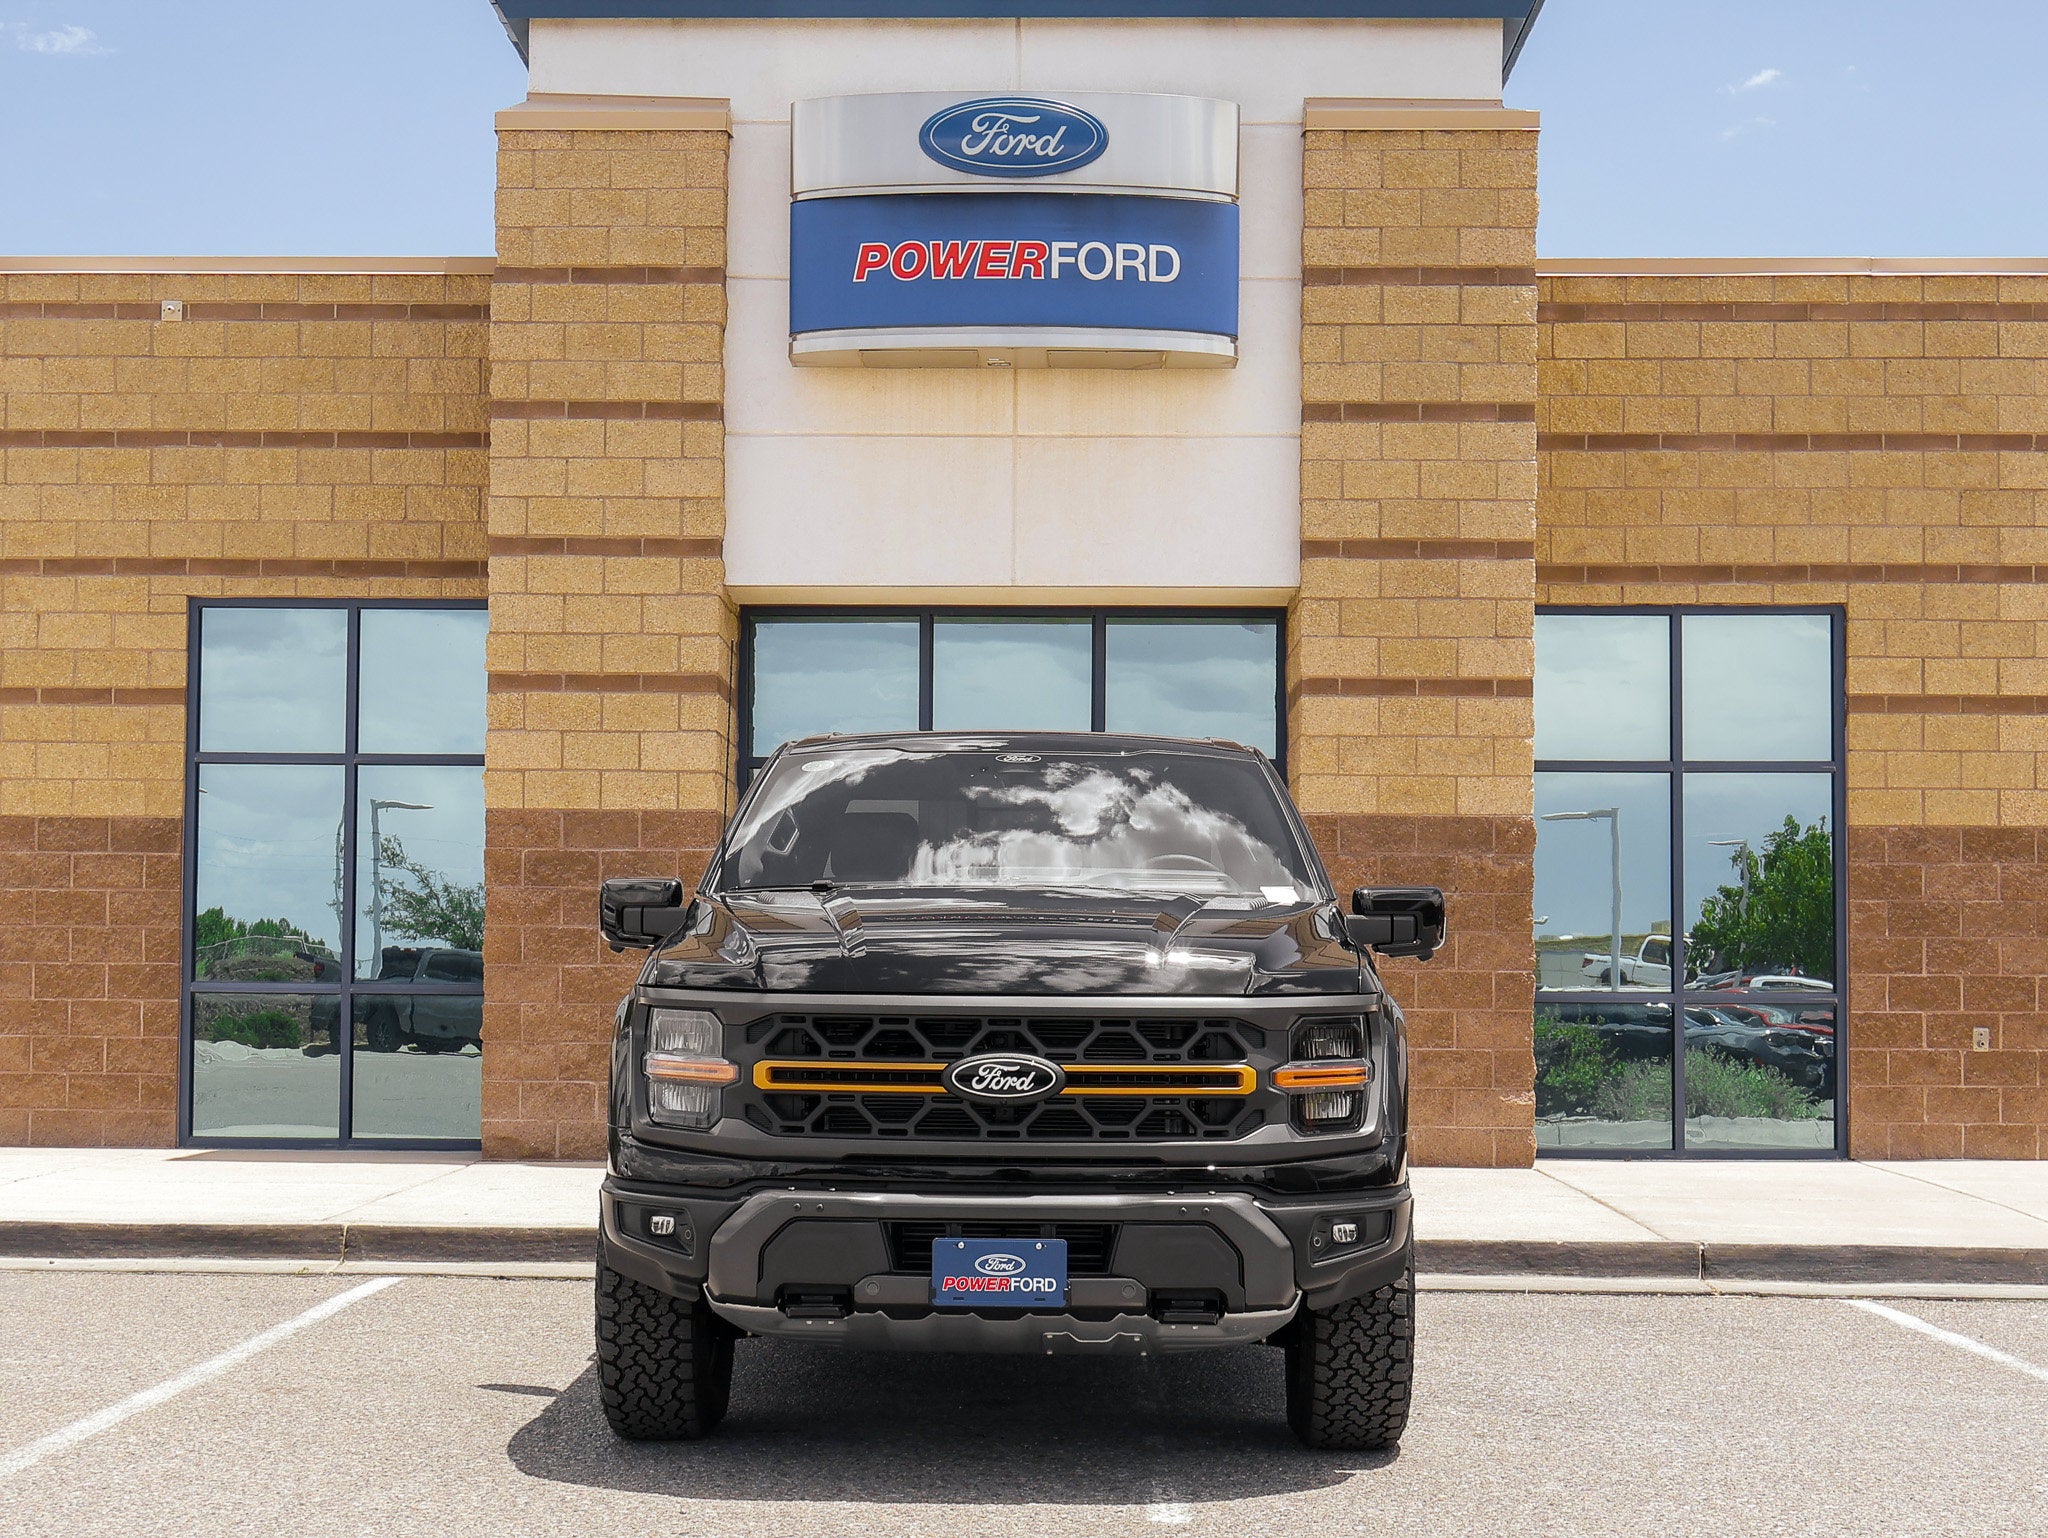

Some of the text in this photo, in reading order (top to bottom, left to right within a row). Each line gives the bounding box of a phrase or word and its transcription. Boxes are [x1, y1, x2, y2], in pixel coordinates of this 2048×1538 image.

[961, 112, 1067, 157] Ford
[971, 1063, 1036, 1092] Ford
[985, 1257, 1016, 1271] Ford
